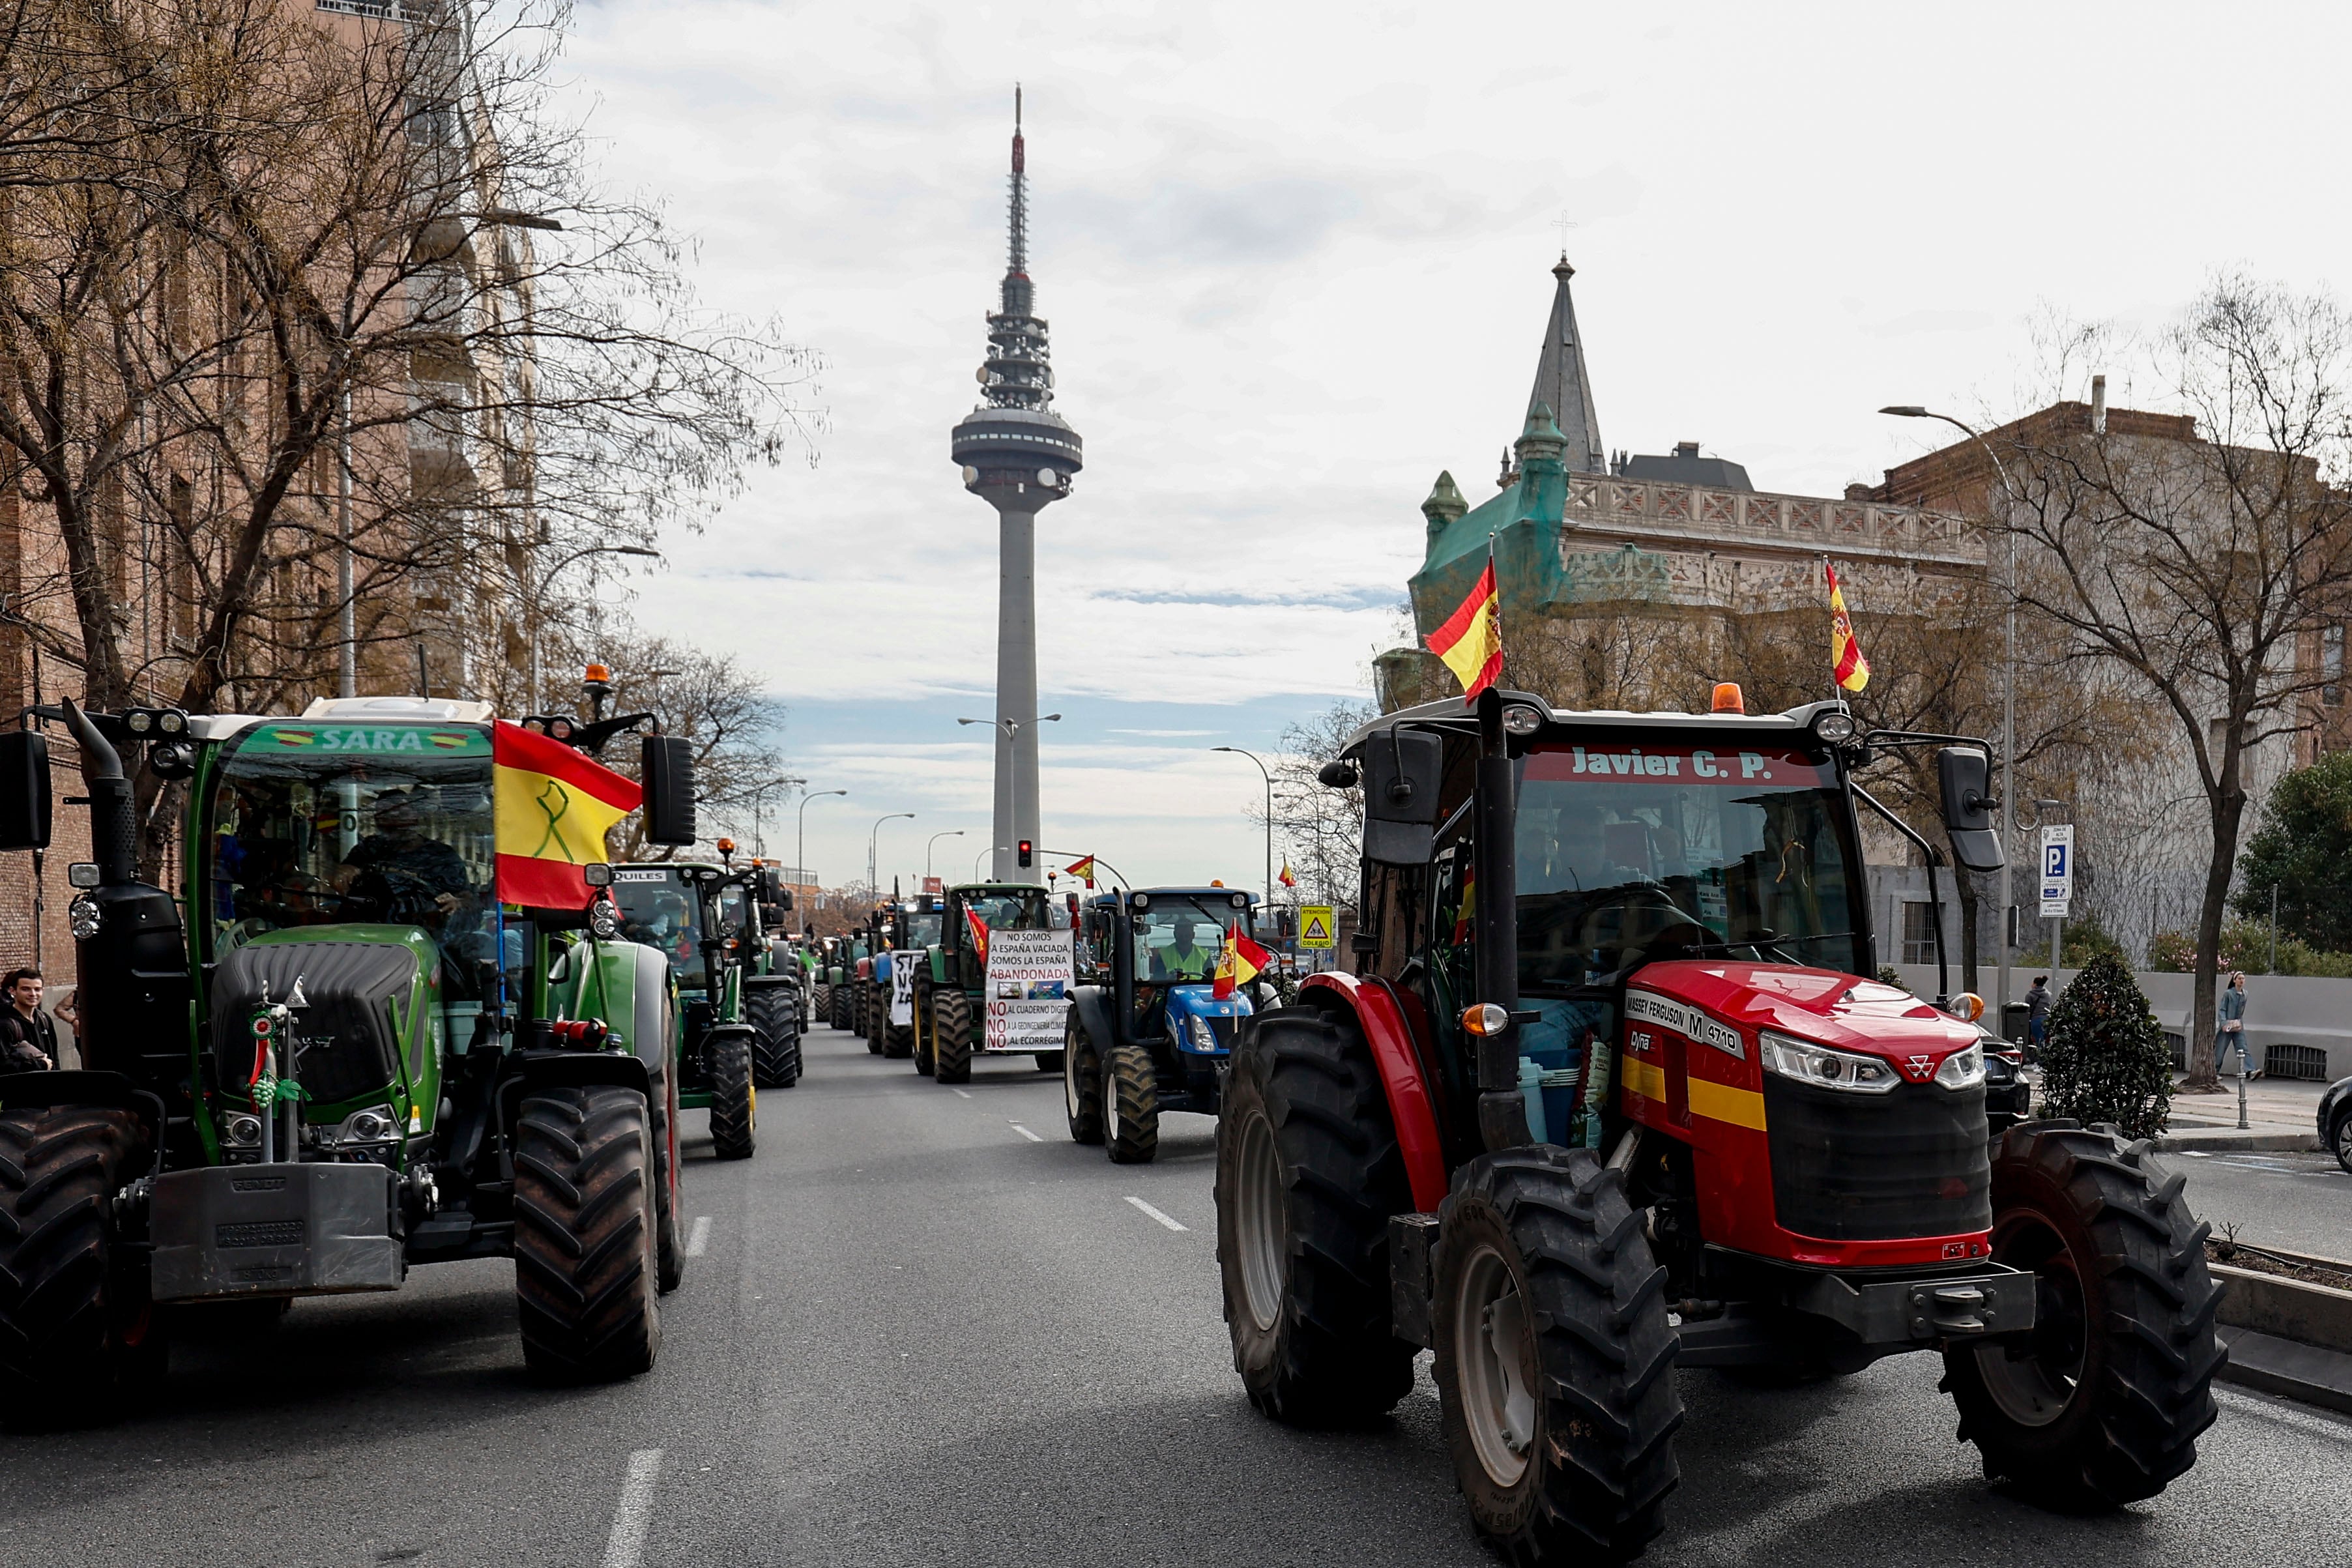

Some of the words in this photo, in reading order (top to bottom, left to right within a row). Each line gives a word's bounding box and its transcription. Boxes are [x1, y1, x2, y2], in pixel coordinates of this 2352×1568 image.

[323, 730, 423, 750] SARA
[1572, 747, 1681, 776] Javier
[1692, 751, 1728, 778] C.
[1739, 752, 1772, 779] P.
[2048, 849, 2061, 874] P
[615, 872, 663, 881] QUILES
[1022, 933, 1051, 941] SOMOS
[1000, 944, 1030, 953] ESPAÑA
[1033, 945, 1070, 953] VACIADA,
[991, 956, 1022, 965] SOMOS
[1036, 955, 1067, 965] ESPAÑA
[990, 968, 1070, 980] ABANDONADA
[1017, 1005, 1049, 1014] CUADERNO
[1051, 1006, 1069, 1014] DIGITA
[1051, 1019, 1066, 1030] CLIMÁT
[1627, 996, 1649, 1015] MASSEY
[1648, 1000, 1685, 1027] FERGUSON
[1689, 1011, 1703, 1040] M
[1707, 1023, 1736, 1051] 4710
[1021, 1034, 1065, 1045] ECORRÉGIM
